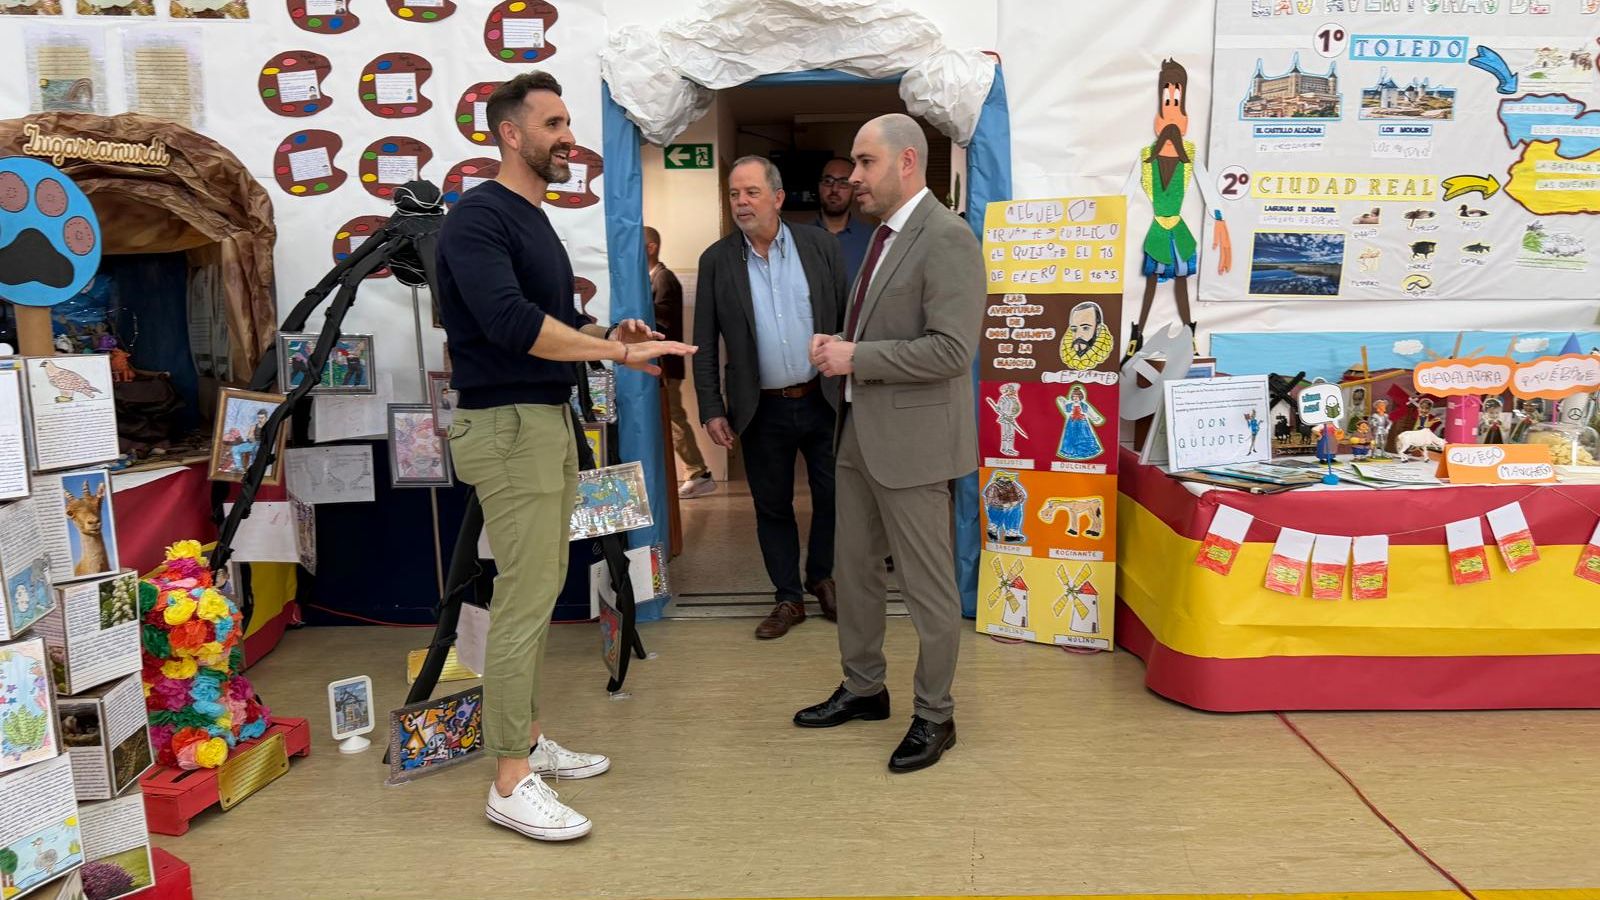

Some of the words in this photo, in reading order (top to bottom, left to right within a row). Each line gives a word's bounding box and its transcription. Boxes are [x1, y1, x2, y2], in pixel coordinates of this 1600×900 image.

[1355, 39, 1462, 58] TOLEDO
[1257, 176, 1358, 194] CIUDAD
[1367, 178, 1434, 196] REAL
[1076, 246, 1089, 258] EL
[991, 270, 1004, 281] DE
[1064, 267, 1081, 280] DE
[1197, 417, 1226, 429] DON
[1178, 433, 1245, 449] QUIJOTE
[1451, 447, 1502, 466] QUESO
[1060, 462, 1096, 470] DULCINEA
[998, 626, 1025, 636] MOLINO
[1067, 636, 1096, 644] MOLINO
